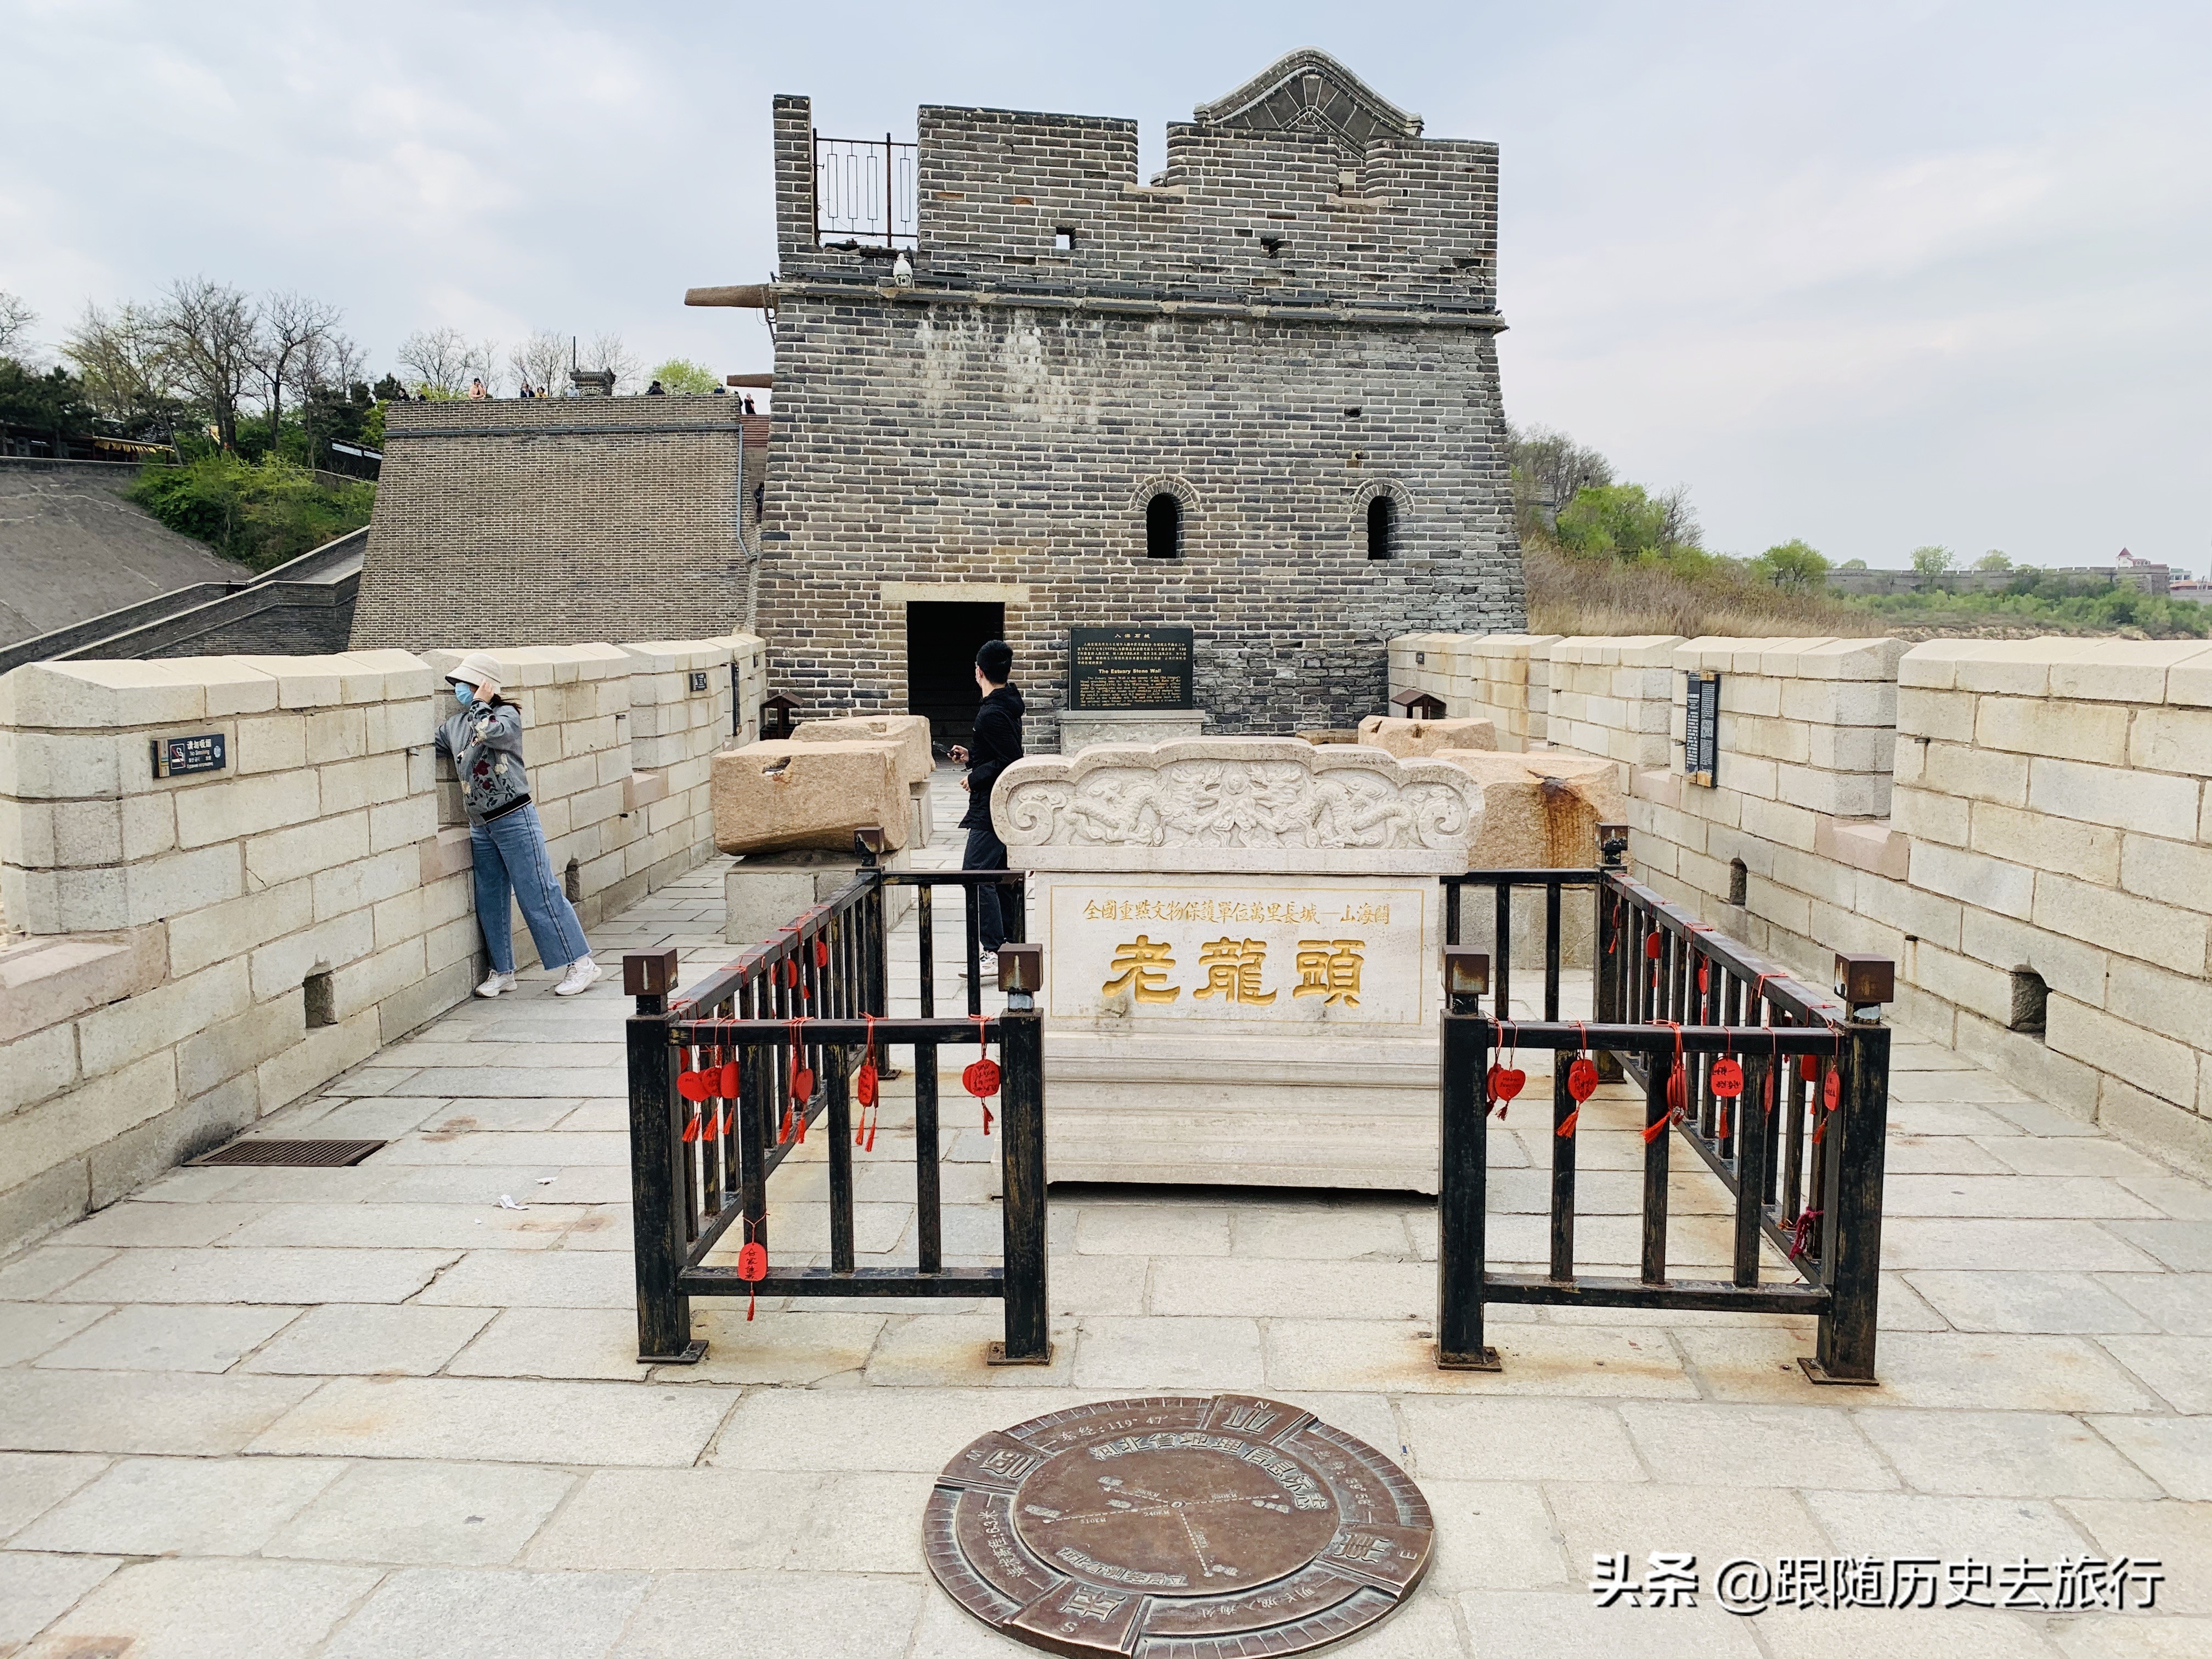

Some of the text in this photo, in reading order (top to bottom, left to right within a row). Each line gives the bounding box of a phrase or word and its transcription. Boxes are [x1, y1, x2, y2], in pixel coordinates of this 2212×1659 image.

[1101, 934, 1366, 1009] 老龍頭
[1254, 1401, 1271, 1410] N
[1088, 1431, 1328, 1510] 河北省地理信息标志
[1399, 1550, 1418, 1560] E
[1060, 1621, 1079, 1633] S
